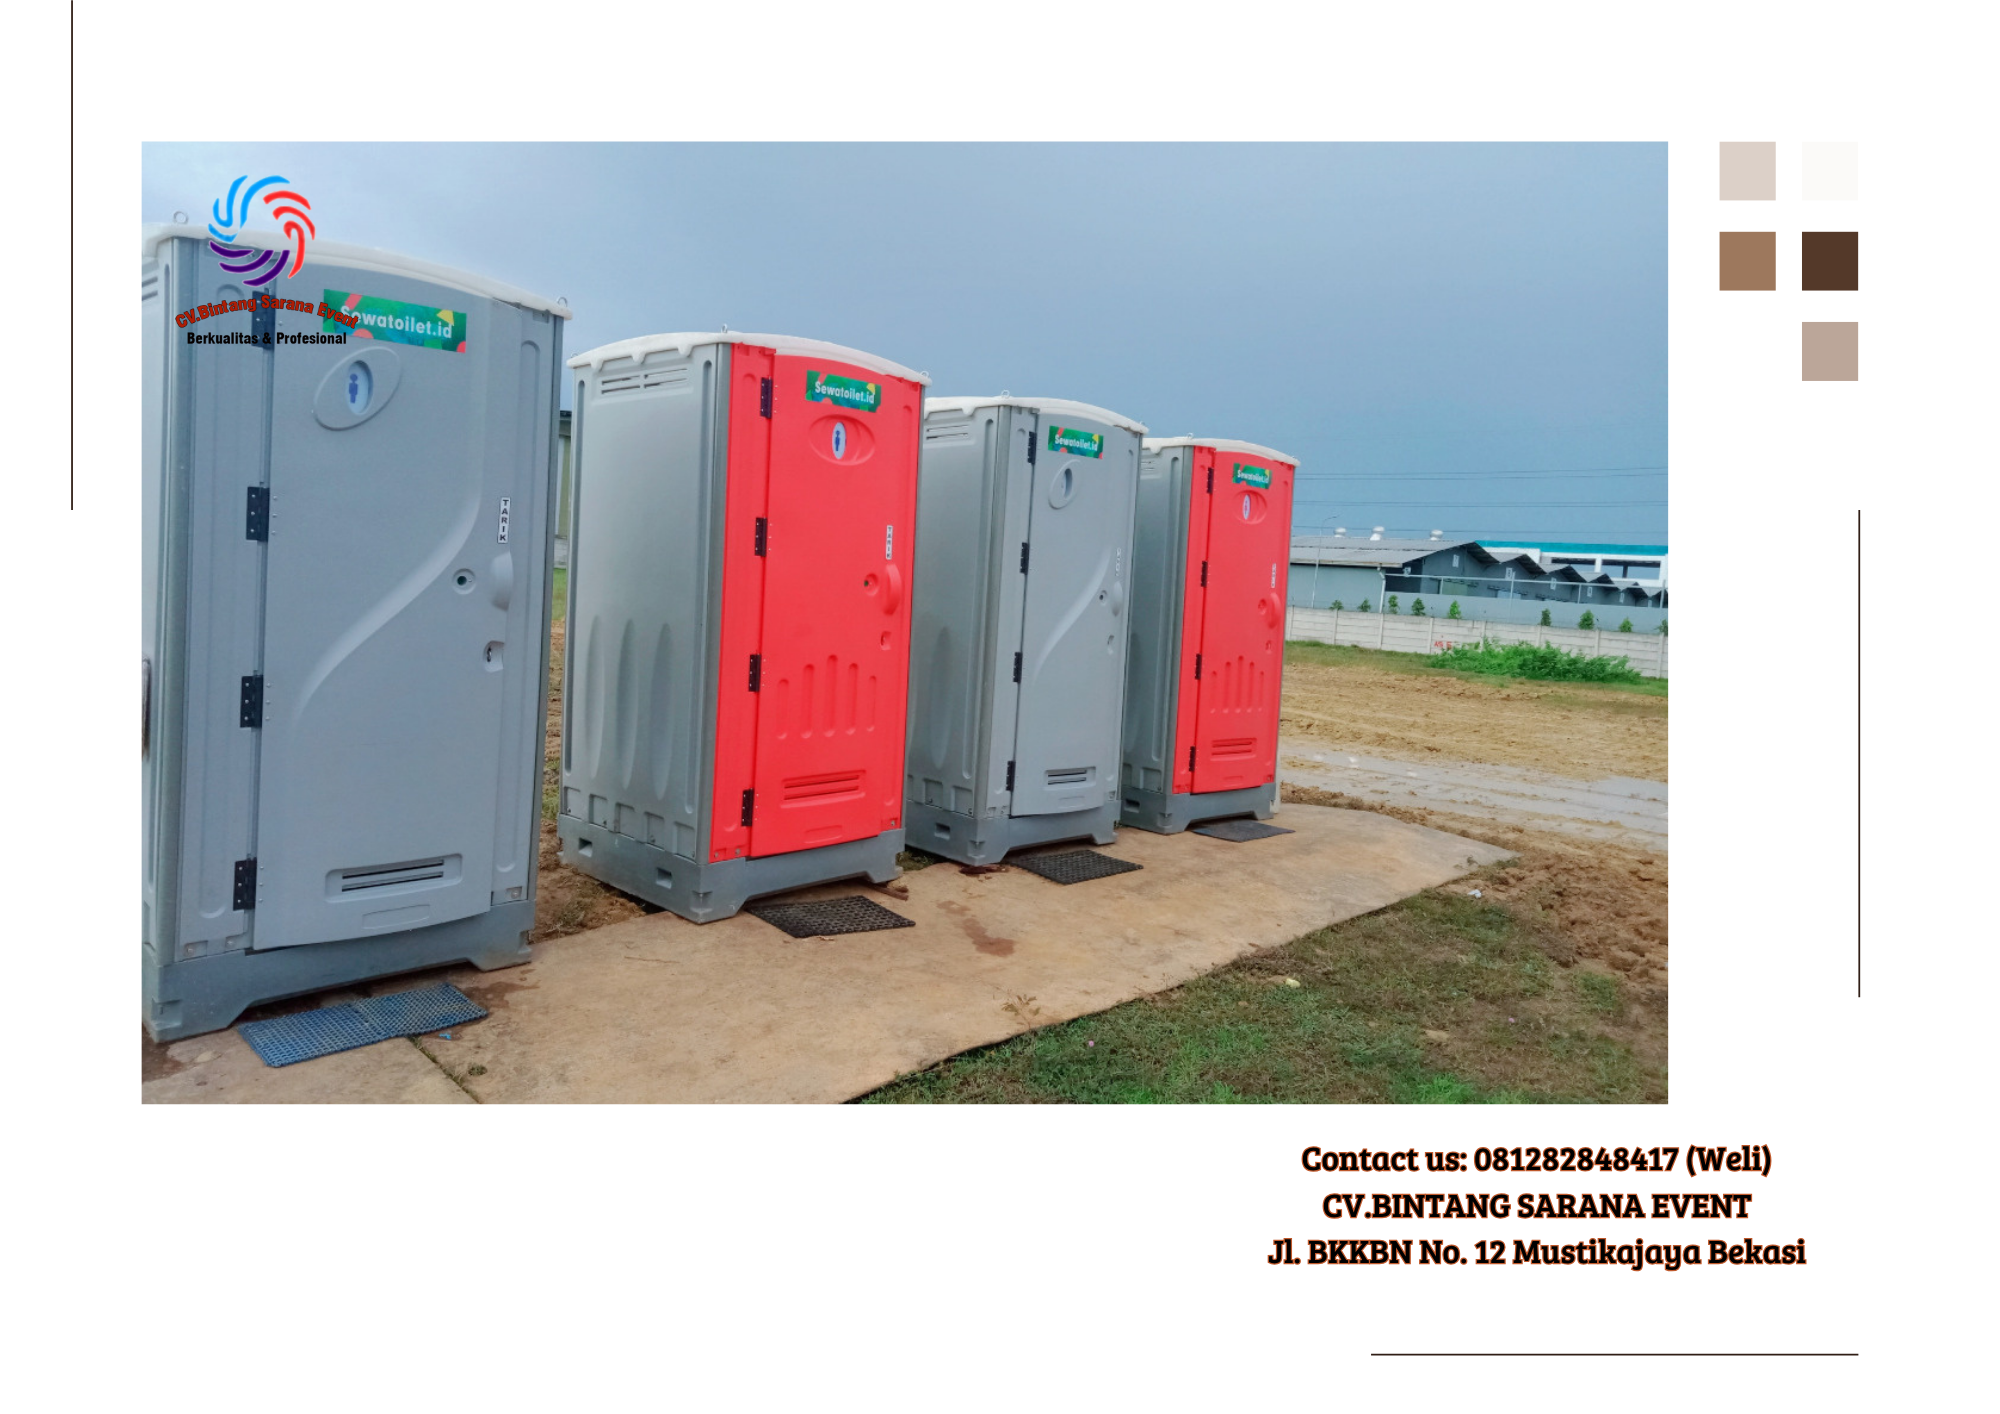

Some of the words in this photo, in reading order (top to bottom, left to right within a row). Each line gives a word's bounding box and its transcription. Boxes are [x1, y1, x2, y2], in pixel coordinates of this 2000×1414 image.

[814, 381, 875, 405] Sewatoilet.id
[1054, 434, 1099, 452] Sewatoilet.id
[499, 499, 510, 542] TARIK
